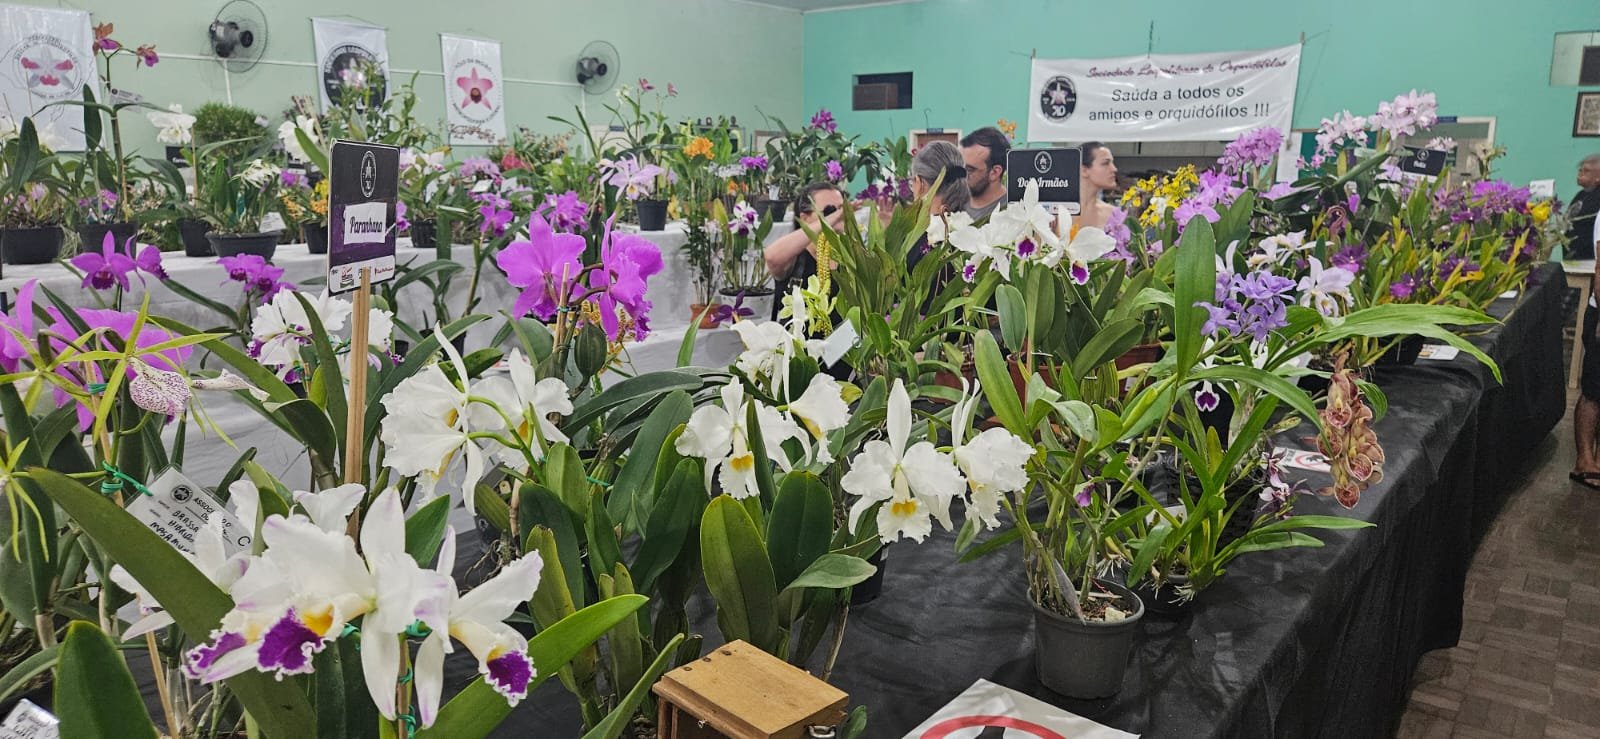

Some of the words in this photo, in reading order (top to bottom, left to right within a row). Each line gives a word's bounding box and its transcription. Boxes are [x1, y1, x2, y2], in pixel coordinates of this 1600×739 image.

[1111, 84, 1158, 102] Saúda
[1163, 89, 1172, 100] a
[1177, 84, 1221, 100] todos
[1226, 86, 1245, 97] os
[1088, 107, 1140, 124] amigos
[1144, 110, 1153, 119] e
[1158, 104, 1248, 121] orquidófilos
[1253, 103, 1270, 117] !!!
[1037, 176, 1069, 188] Irmãos
[237, 535, 251, 547] C
